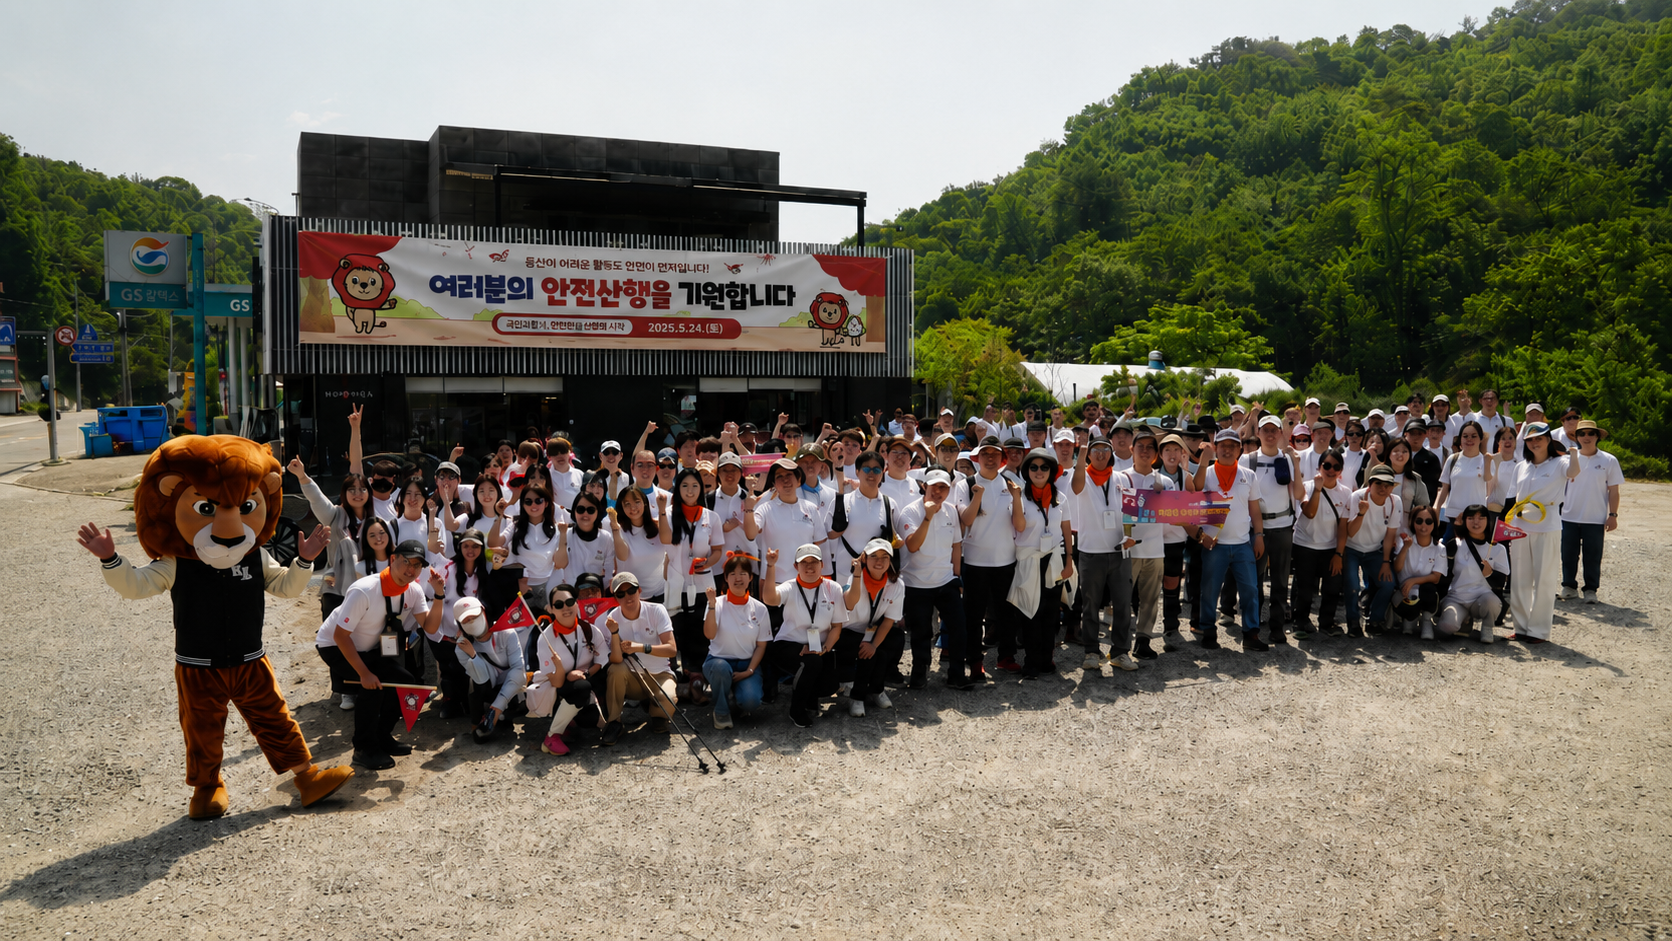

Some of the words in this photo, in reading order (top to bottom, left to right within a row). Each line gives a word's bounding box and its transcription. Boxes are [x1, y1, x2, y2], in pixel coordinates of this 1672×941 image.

[525, 257, 556, 269] 등산이
[559, 258, 590, 270] 어려운
[121, 288, 143, 302] GS
[429, 274, 534, 304] 여러분의
[541, 277, 672, 310] 안전산행을
[678, 281, 796, 310] 기원합니다
[229, 299, 250, 312] GS
